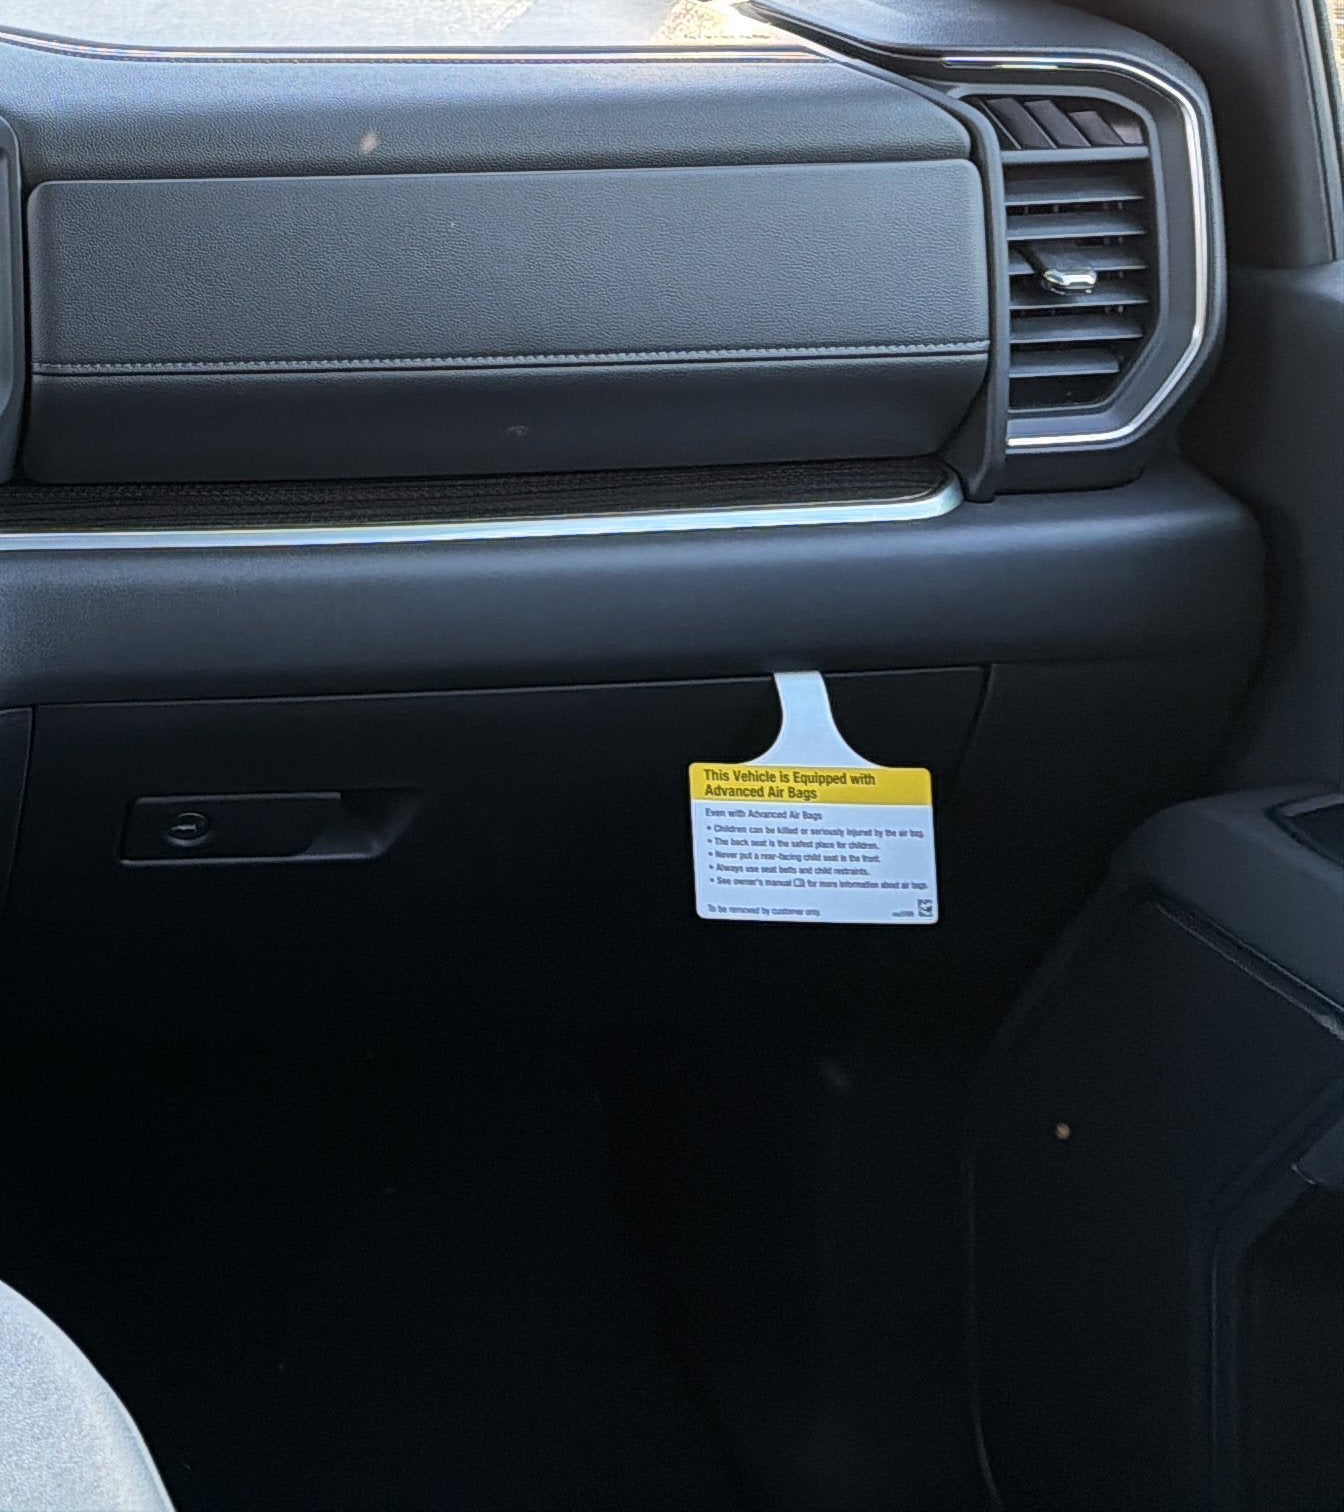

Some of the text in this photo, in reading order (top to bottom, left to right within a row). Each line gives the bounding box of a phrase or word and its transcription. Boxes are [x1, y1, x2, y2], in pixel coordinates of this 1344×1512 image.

[704, 769, 876, 786] This Vehicle is Equipped with
[705, 784, 818, 801] Advanced Air Bags
[705, 808, 822, 821] Even with Advanced Air Bags
